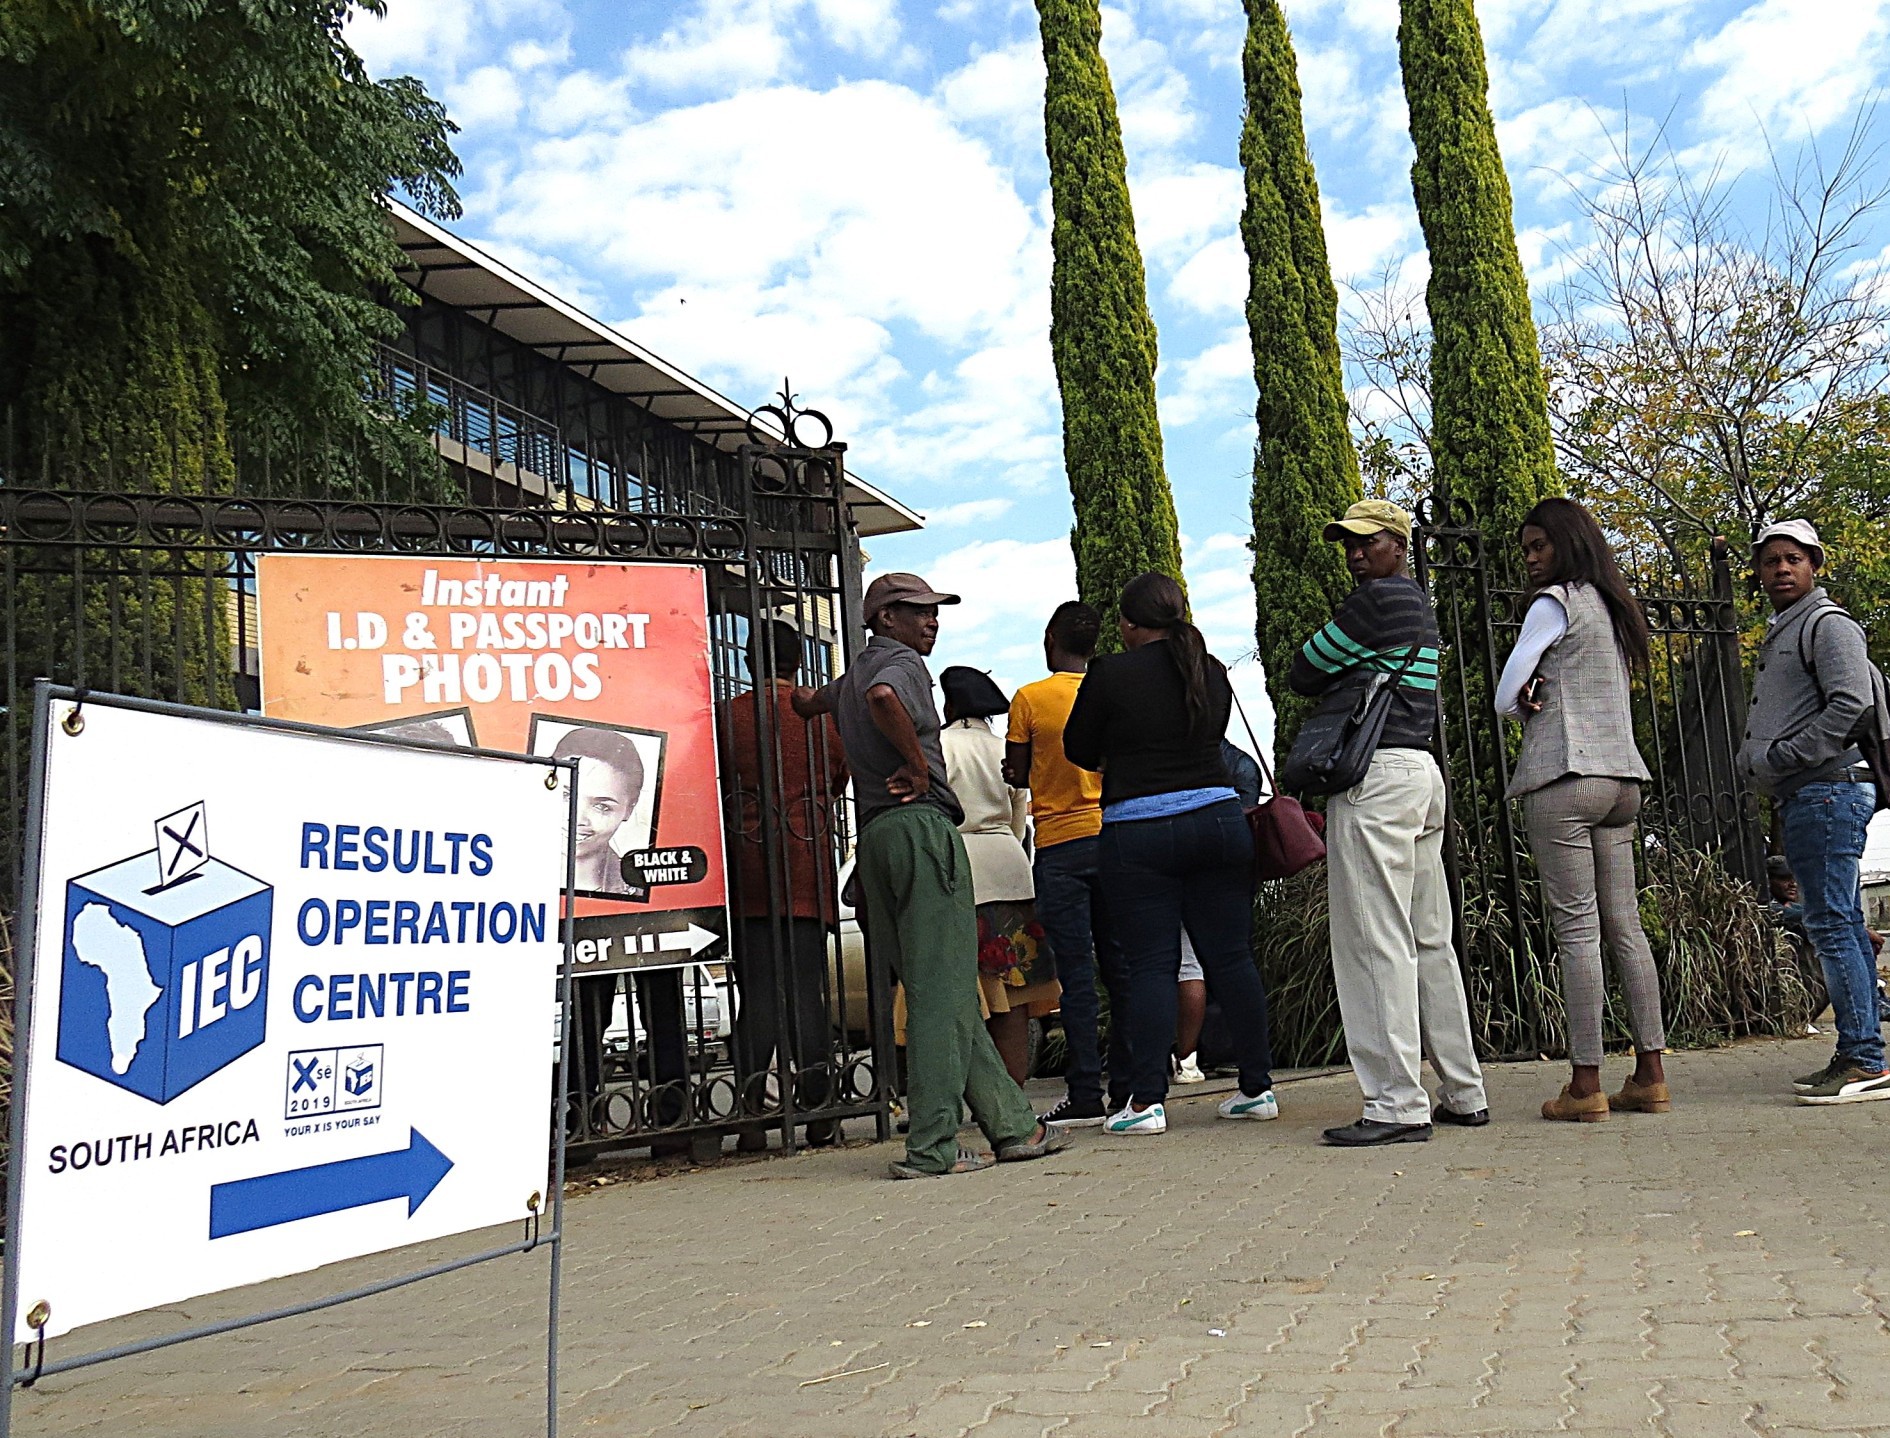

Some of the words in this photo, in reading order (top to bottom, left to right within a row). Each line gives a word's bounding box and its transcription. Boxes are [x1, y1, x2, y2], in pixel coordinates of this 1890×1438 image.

[420, 569, 569, 607] Instant
[326, 611, 388, 650] I.D
[402, 611, 438, 650] &
[449, 612, 650, 650] PASSPORT
[381, 652, 602, 705] PHOTOS
[300, 822, 493, 876] RESULTS
[633, 851, 678, 868] BLACK
[681, 850, 693, 864] &
[643, 867, 689, 883] WHITE
[296, 897, 546, 947] OPERATION
[178, 934, 264, 1040] IEC
[292, 970, 471, 1024] CENTRE
[284, 1124, 312, 1137] YOUR
[313, 1123, 321, 1133] X
[322, 1121, 333, 1132] IS
[335, 1118, 361, 1130] YOUR
[363, 1115, 381, 1126] SAY
[290, 1096, 331, 1112] 2019
[47, 1132, 153, 1175] SOUTH
[159, 1118, 260, 1157] AFRICA
